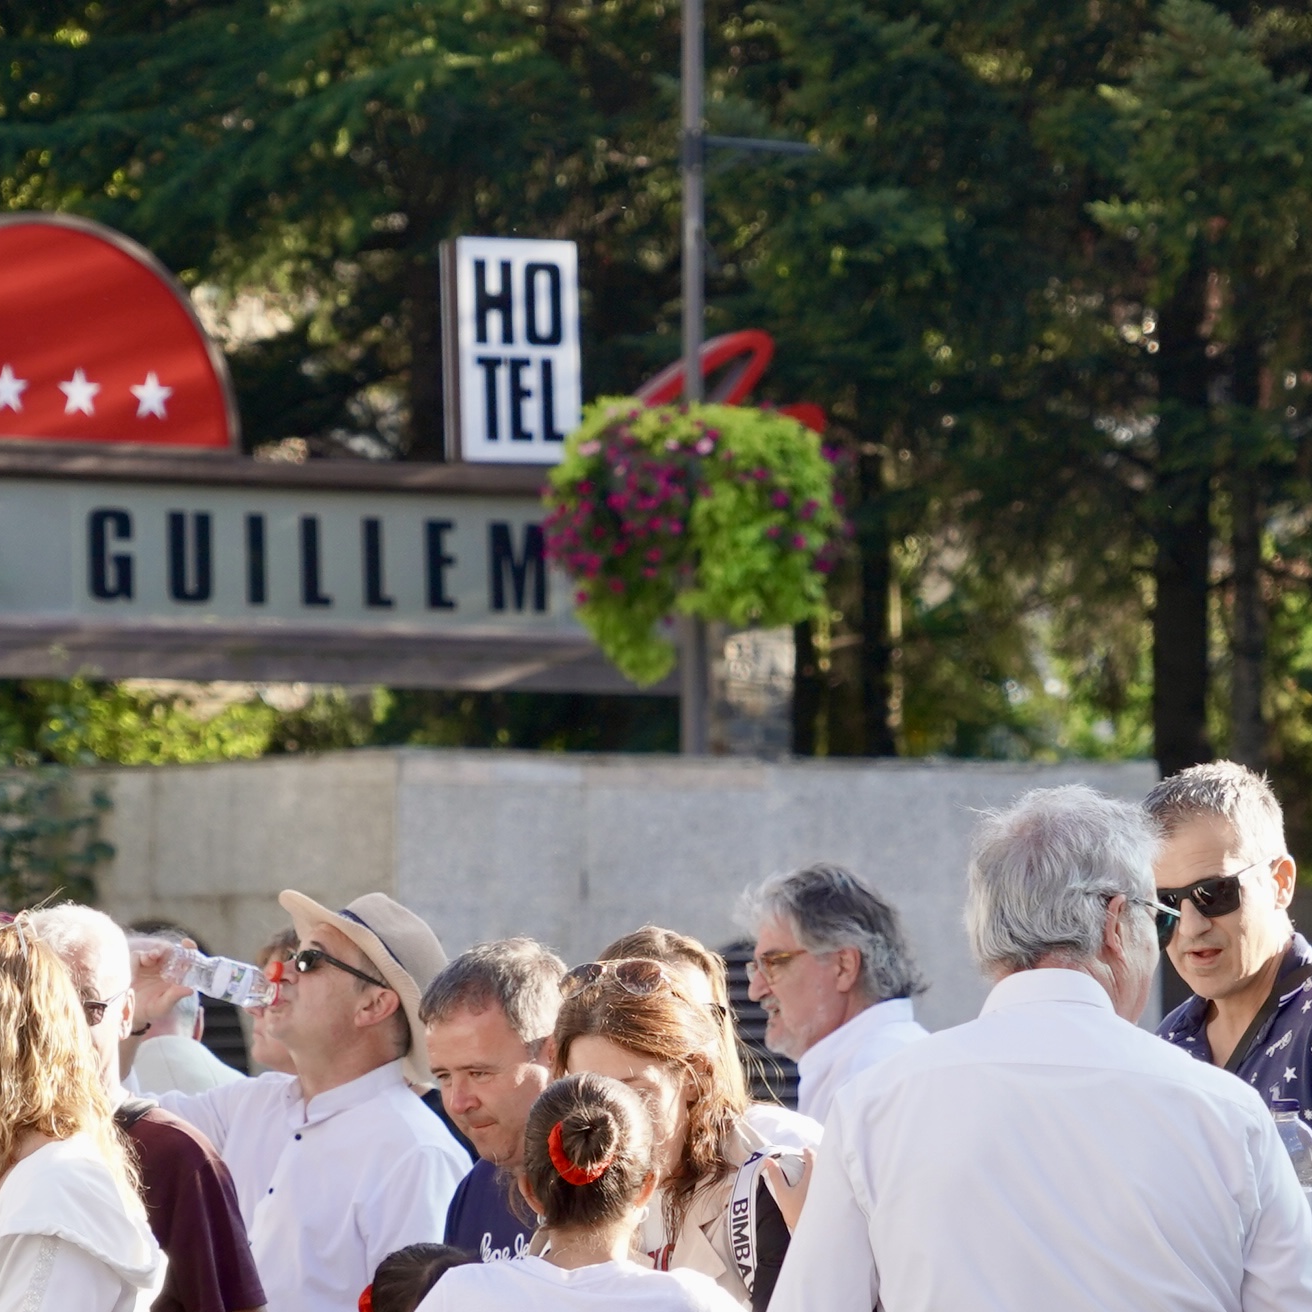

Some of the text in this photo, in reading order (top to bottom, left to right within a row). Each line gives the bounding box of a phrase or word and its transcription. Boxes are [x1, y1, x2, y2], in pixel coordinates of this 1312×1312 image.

[473, 260, 562, 345] HO
[476, 357, 565, 441] TEL
[88, 508, 548, 613] GUILLEM
[731, 1197, 753, 1280] BIMBA
